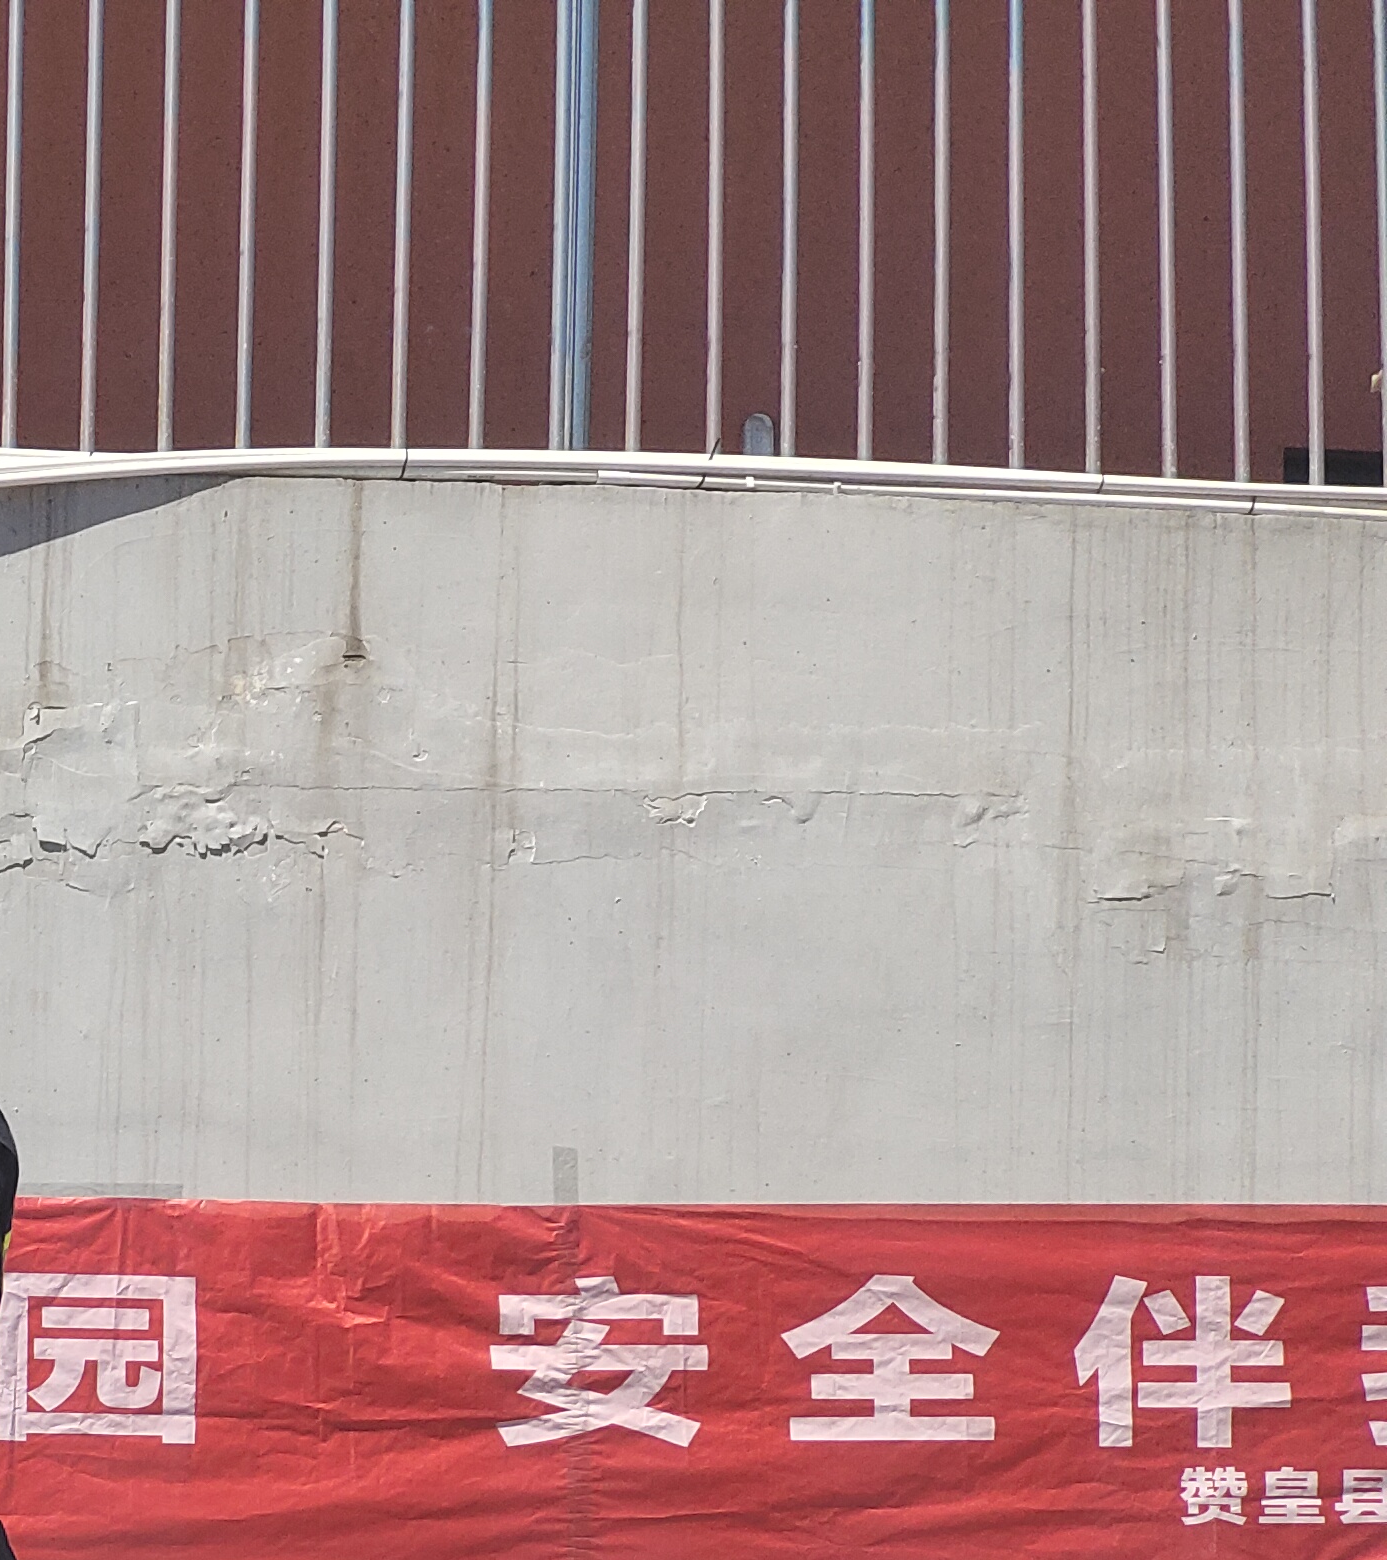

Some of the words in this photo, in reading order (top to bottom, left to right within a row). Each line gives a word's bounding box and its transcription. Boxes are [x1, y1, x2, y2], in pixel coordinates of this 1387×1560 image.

[488, 1274, 1387, 1448] 安全伴
[1180, 1466, 1387, 1526] 赞皇县
